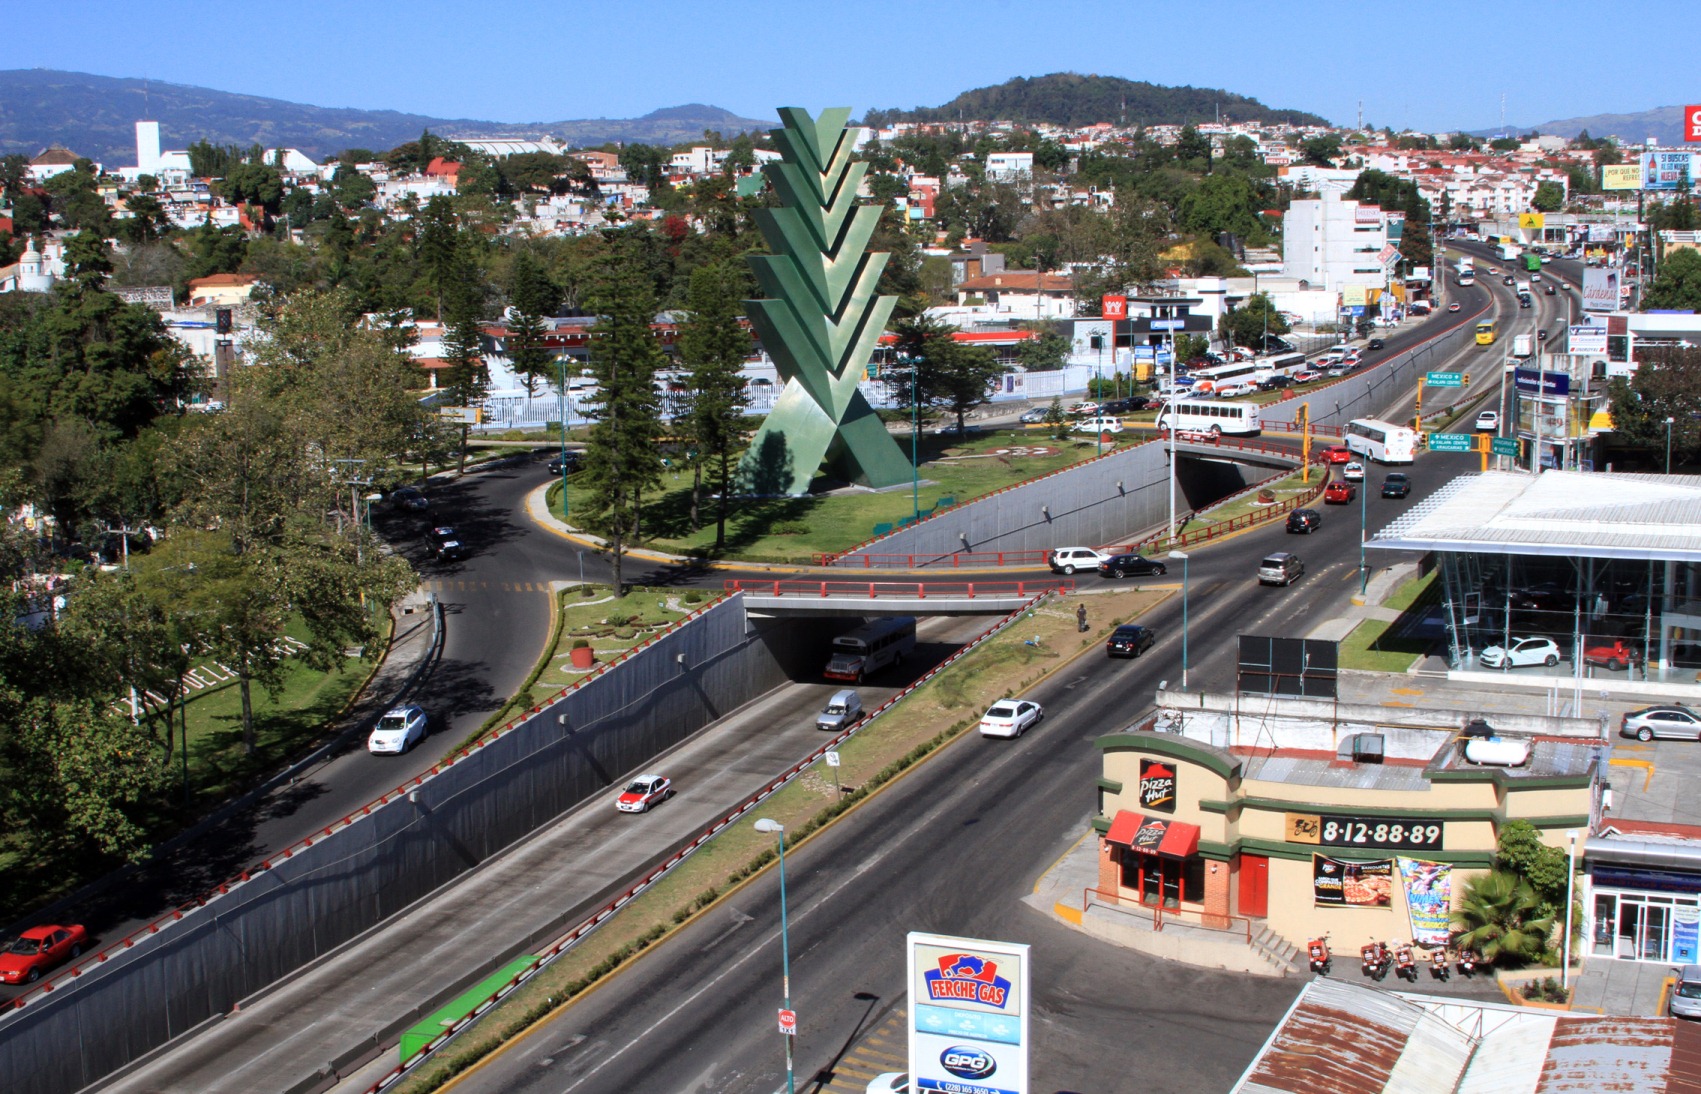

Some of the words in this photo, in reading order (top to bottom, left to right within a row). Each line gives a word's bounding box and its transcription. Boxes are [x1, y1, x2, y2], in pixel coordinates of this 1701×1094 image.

[1661, 154, 1667, 162] SI
[1668, 154, 1689, 162] BUSCAS
[1140, 777, 1173, 798] Pizza
[1145, 788, 1169, 803] Hut
[1135, 828, 1164, 838] Pizza
[1138, 835, 1158, 843] Hut
[930, 979, 977, 1000] FERCHE
[979, 985, 1006, 1006] GAS
[944, 1053, 986, 1070] GPG
[945, 1082, 961, 1092] (228)
[962, 1084, 973, 1093] 165
[973, 1085, 988, 1094] 3650
